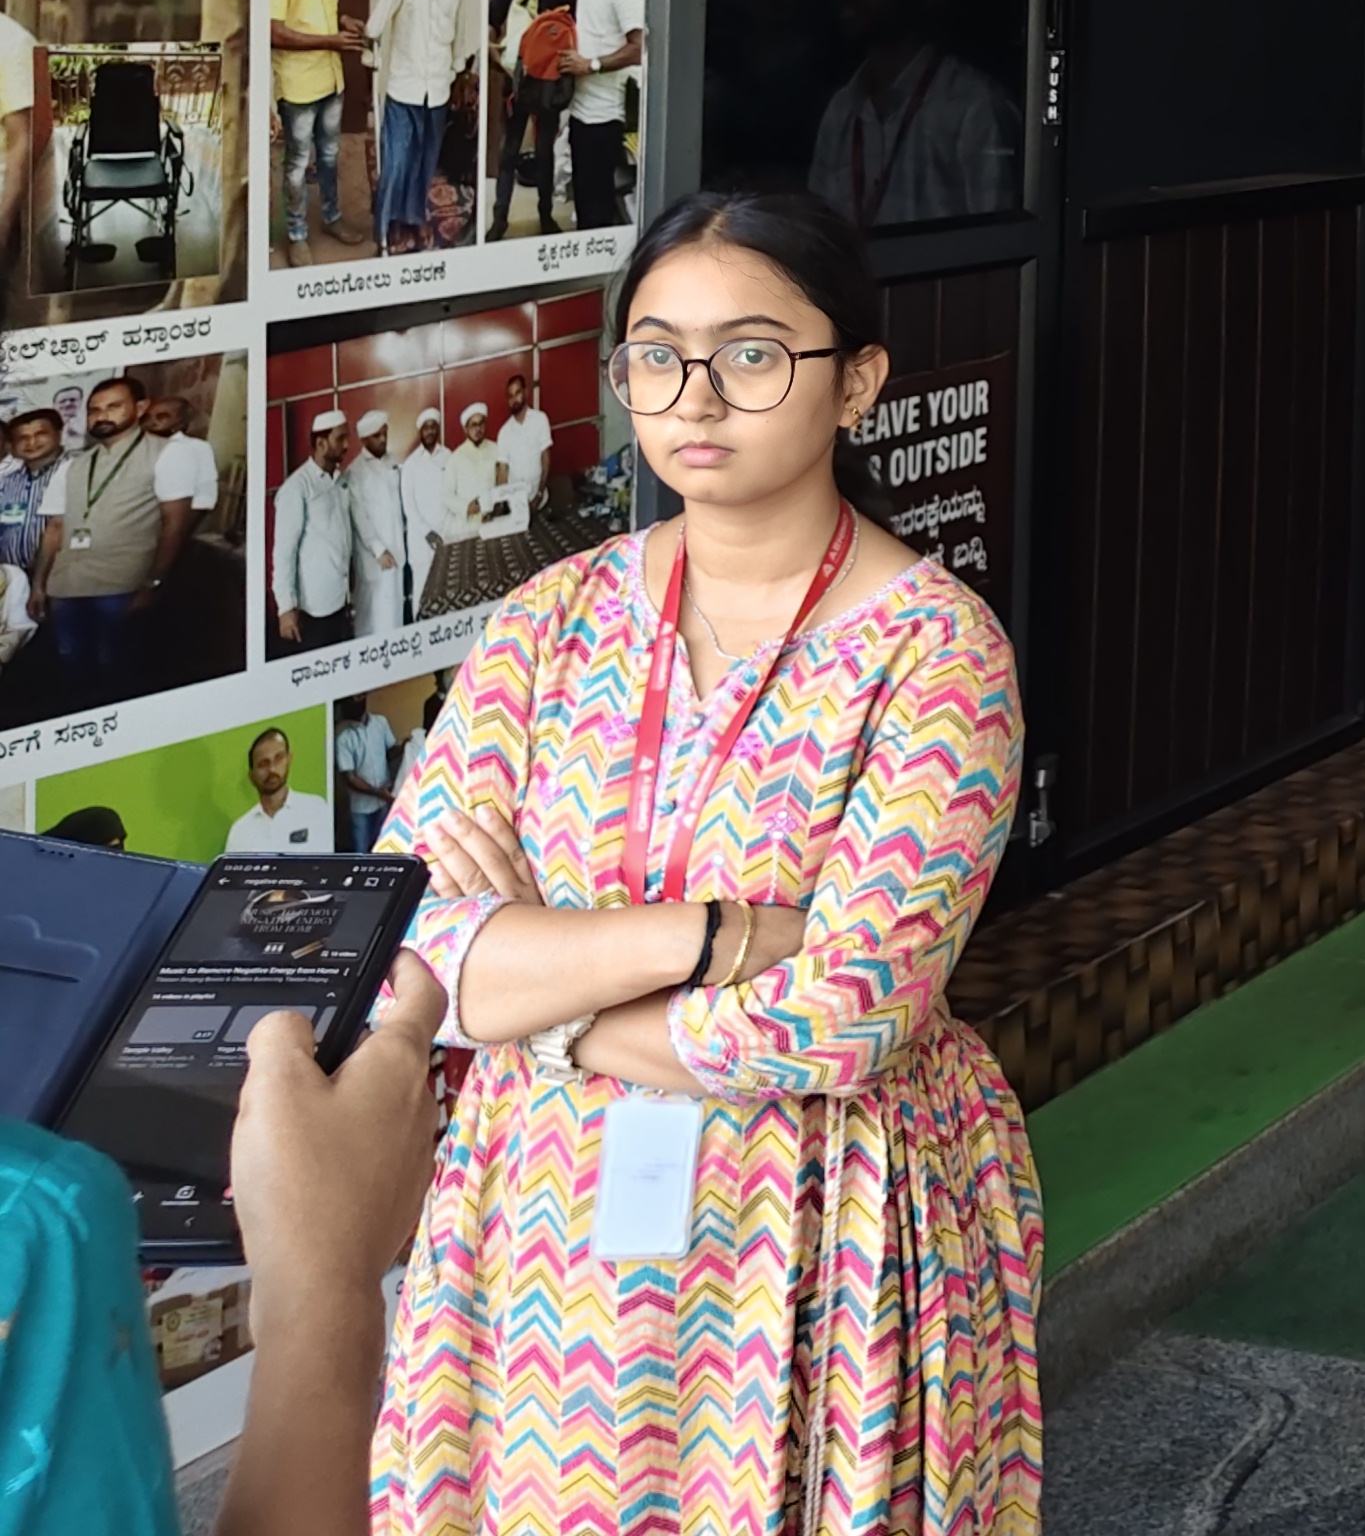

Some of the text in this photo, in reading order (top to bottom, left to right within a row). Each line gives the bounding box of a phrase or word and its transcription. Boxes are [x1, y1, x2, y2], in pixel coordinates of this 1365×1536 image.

[1048, 56, 1059, 120] PUSH
[400, 261, 447, 285] ವಿತರಣೆ
[122, 315, 212, 353] ಹಸ್ತಾಂತರ
[927, 379, 989, 428] YOUR
[889, 426, 988, 487] OUTSIDE
[54, 710, 118, 747] ಸನ್ಮಾನ
